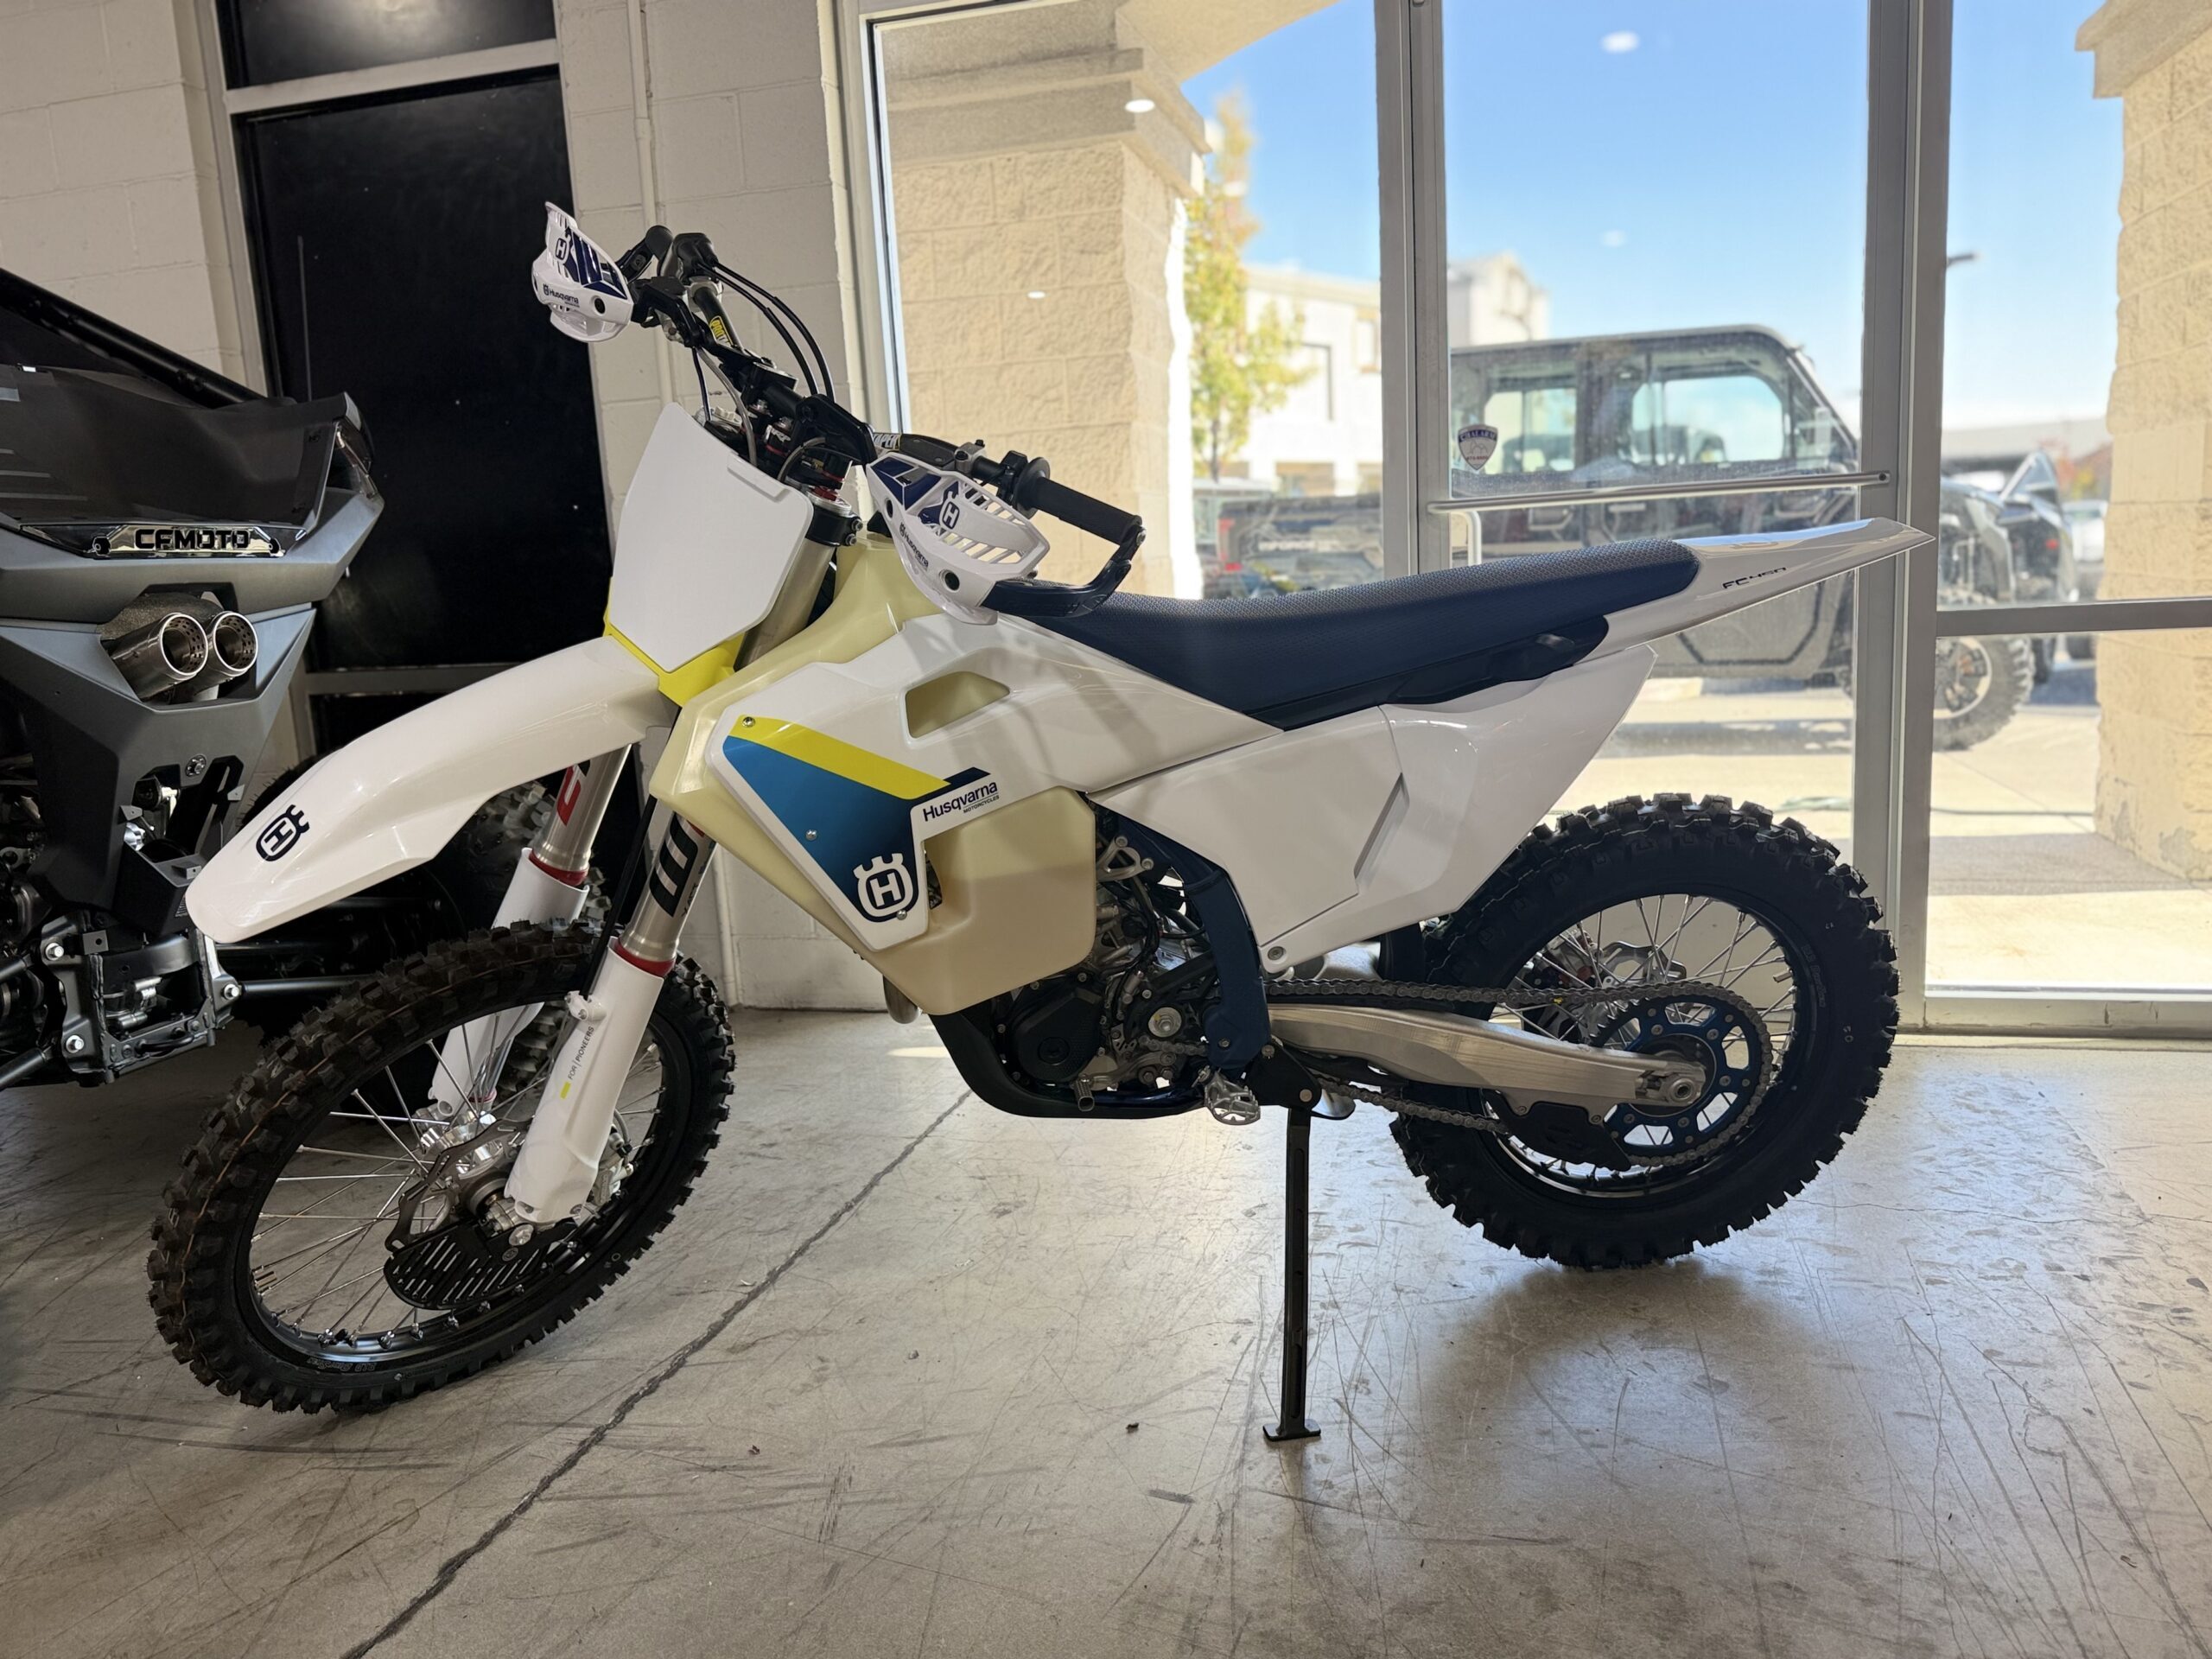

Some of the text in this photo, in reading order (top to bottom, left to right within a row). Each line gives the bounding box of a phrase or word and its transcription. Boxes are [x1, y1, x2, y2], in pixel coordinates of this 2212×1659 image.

[549, 288, 579, 304] Husqvarna
[135, 529, 250, 550] CFMOTO
[904, 532, 929, 568] Husqvarna
[923, 781, 998, 822] Husqvarna
[963, 794, 1000, 814] MOTORCYCLES
[567, 1025, 594, 1080] FOR PIONEERS
